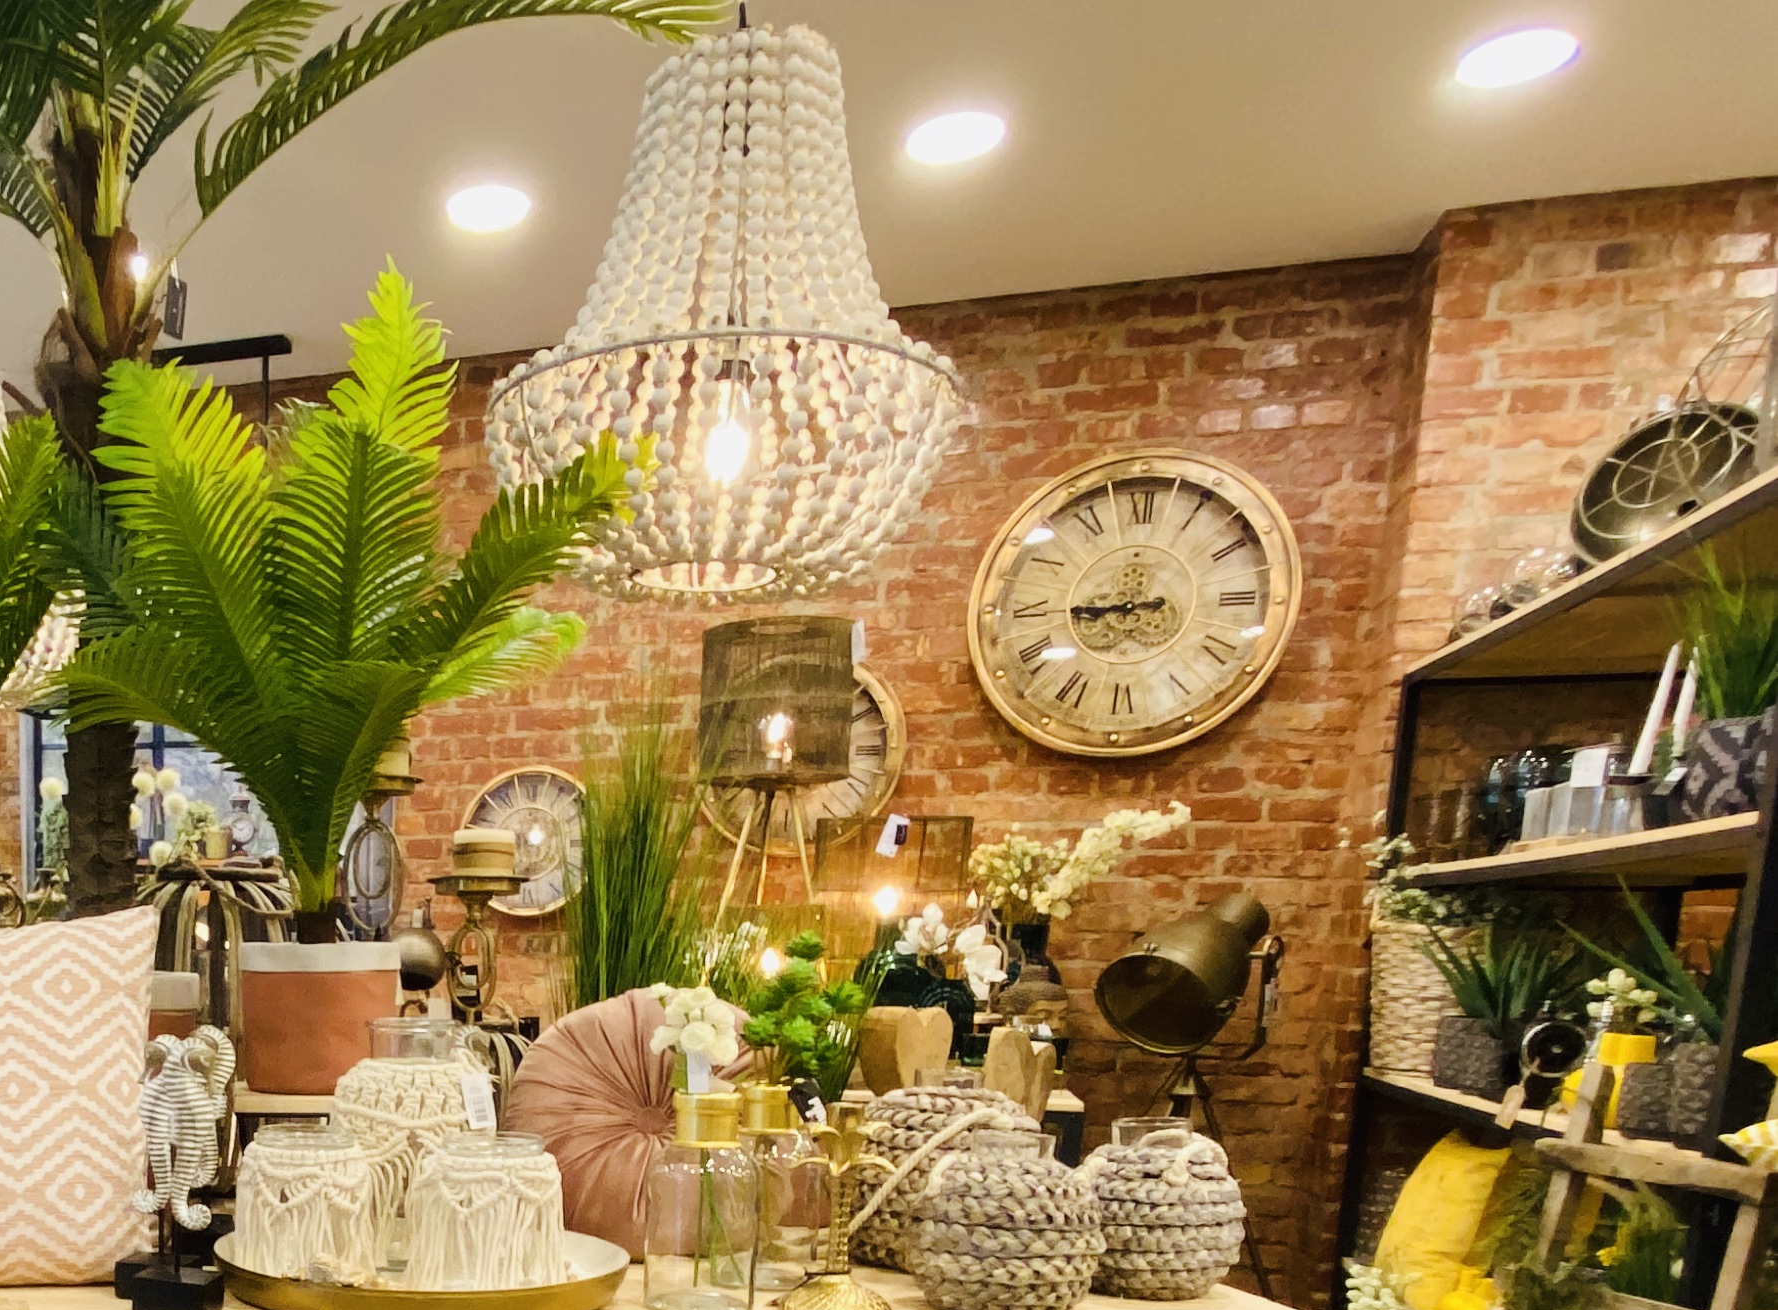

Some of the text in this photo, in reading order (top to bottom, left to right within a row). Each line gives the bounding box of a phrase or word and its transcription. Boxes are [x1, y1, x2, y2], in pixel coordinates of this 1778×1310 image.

[1073, 505, 1104, 542] XI
[1130, 491, 1154, 524] XII
[1211, 538, 1246, 561] II
[1219, 590, 1256, 606] III
[1055, 670, 1090, 709] VII
[1110, 682, 1134, 715] VI
